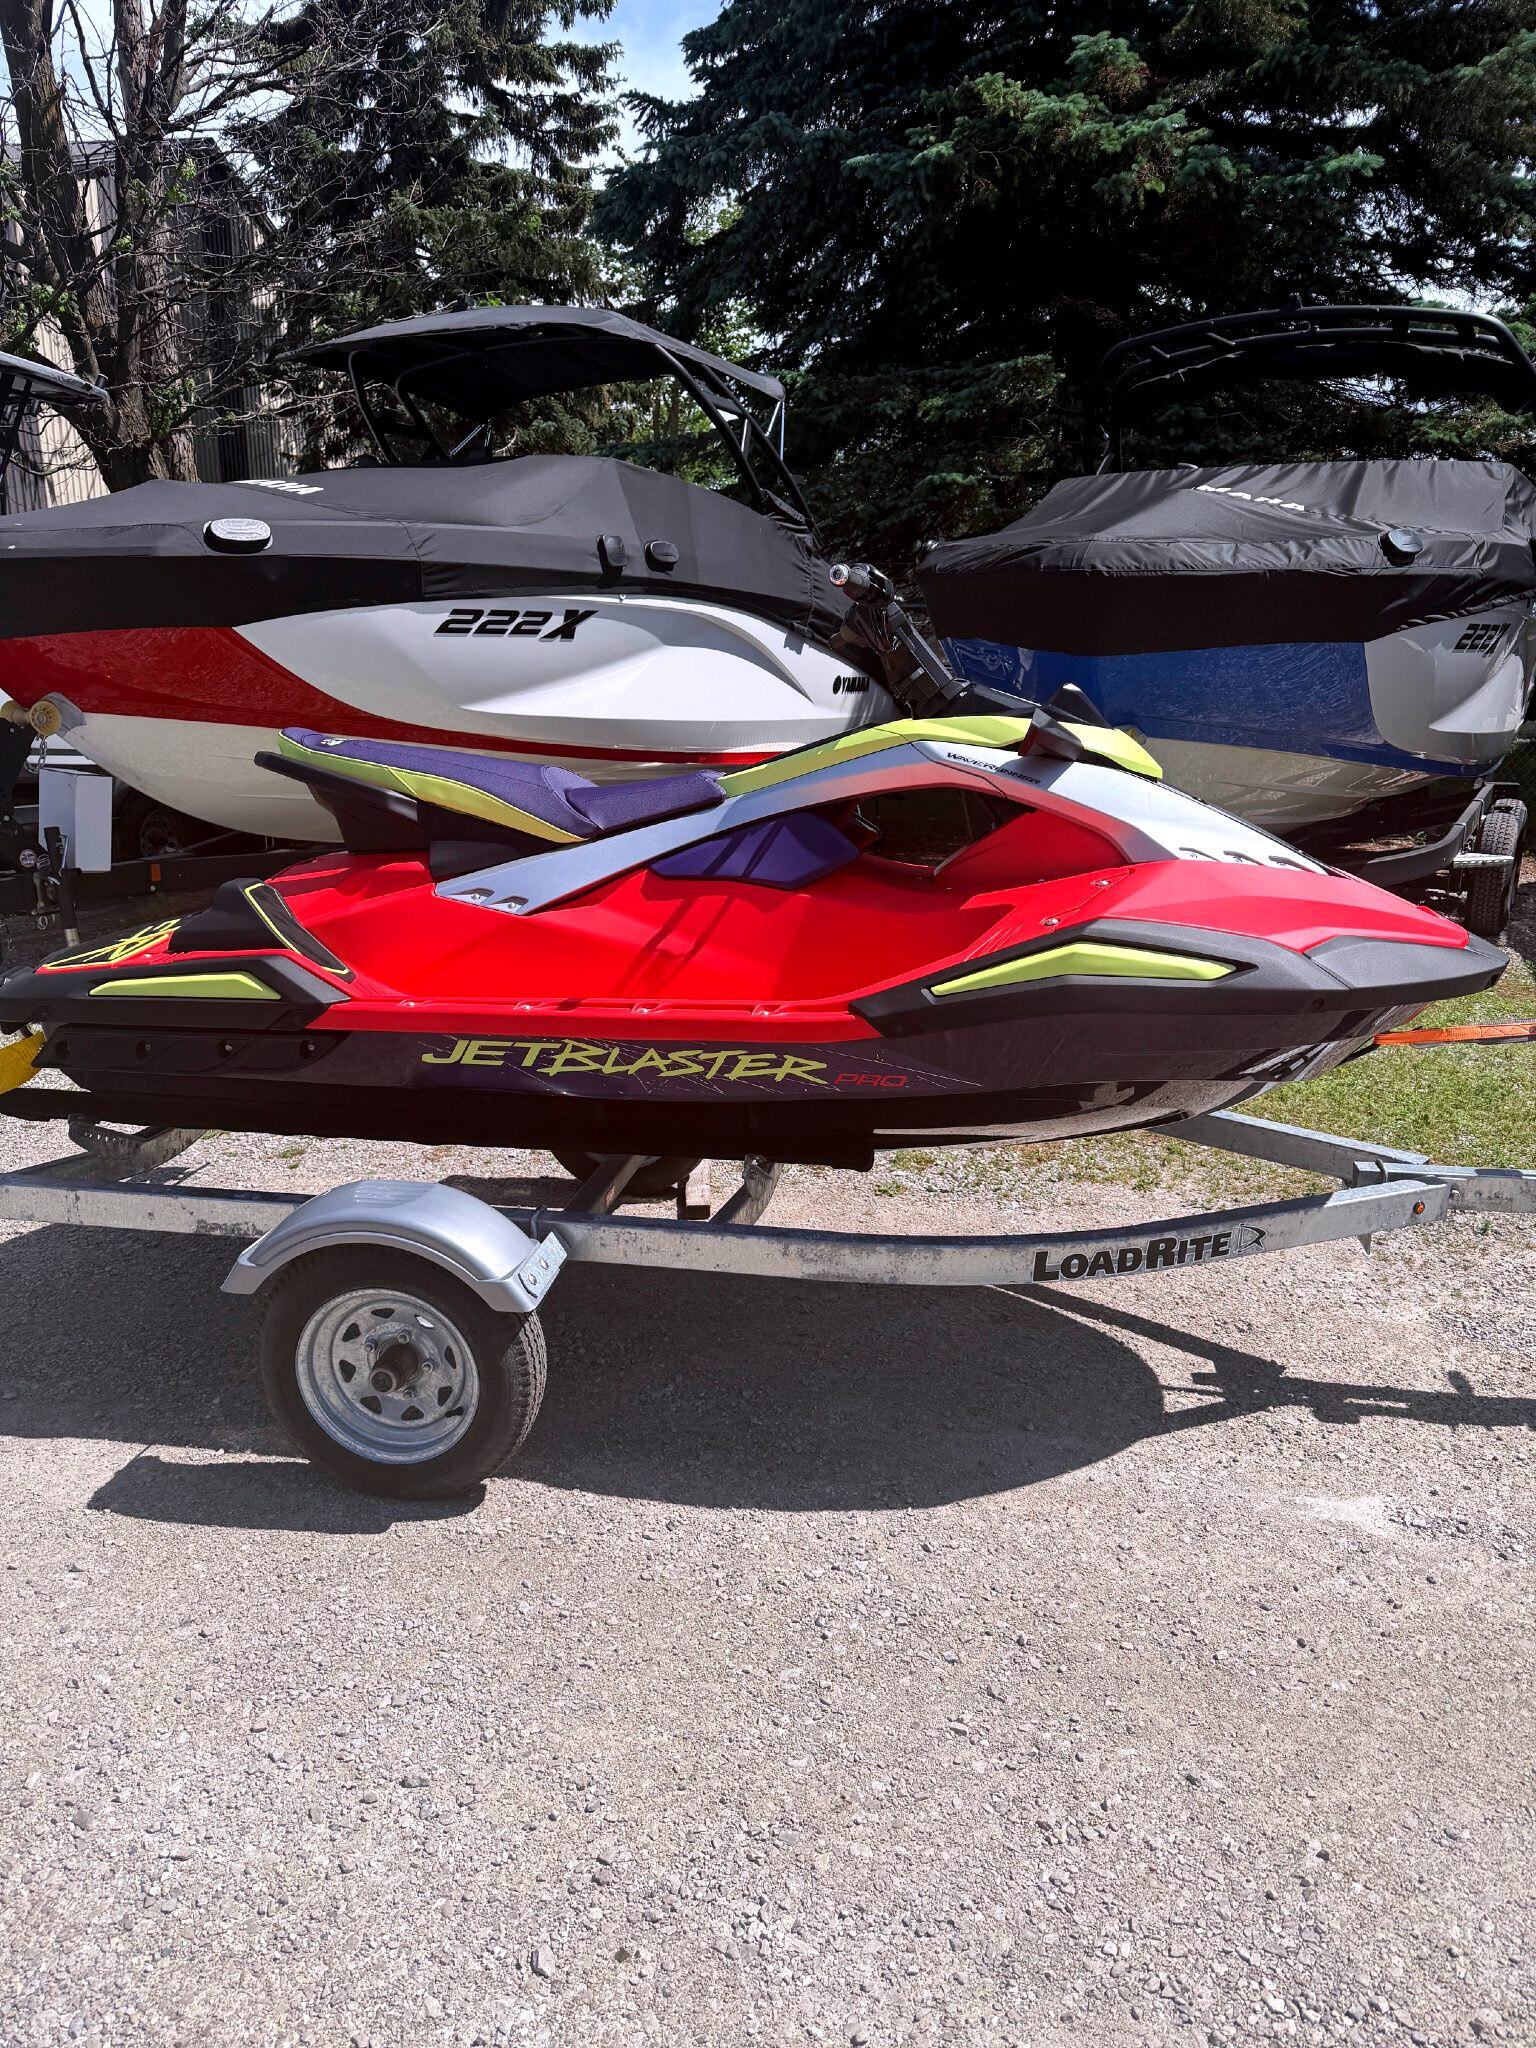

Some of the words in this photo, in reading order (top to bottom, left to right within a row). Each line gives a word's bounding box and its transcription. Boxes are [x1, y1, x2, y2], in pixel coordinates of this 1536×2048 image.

[433, 608, 600, 642] 222X
[1452, 623, 1512, 658] 222X
[947, 752, 1041, 784] WAVERUNNER
[421, 1039, 829, 1085] JETBLASTER
[834, 1073, 908, 1088] PRO
[1032, 1230, 1233, 1282] LOADRITE
